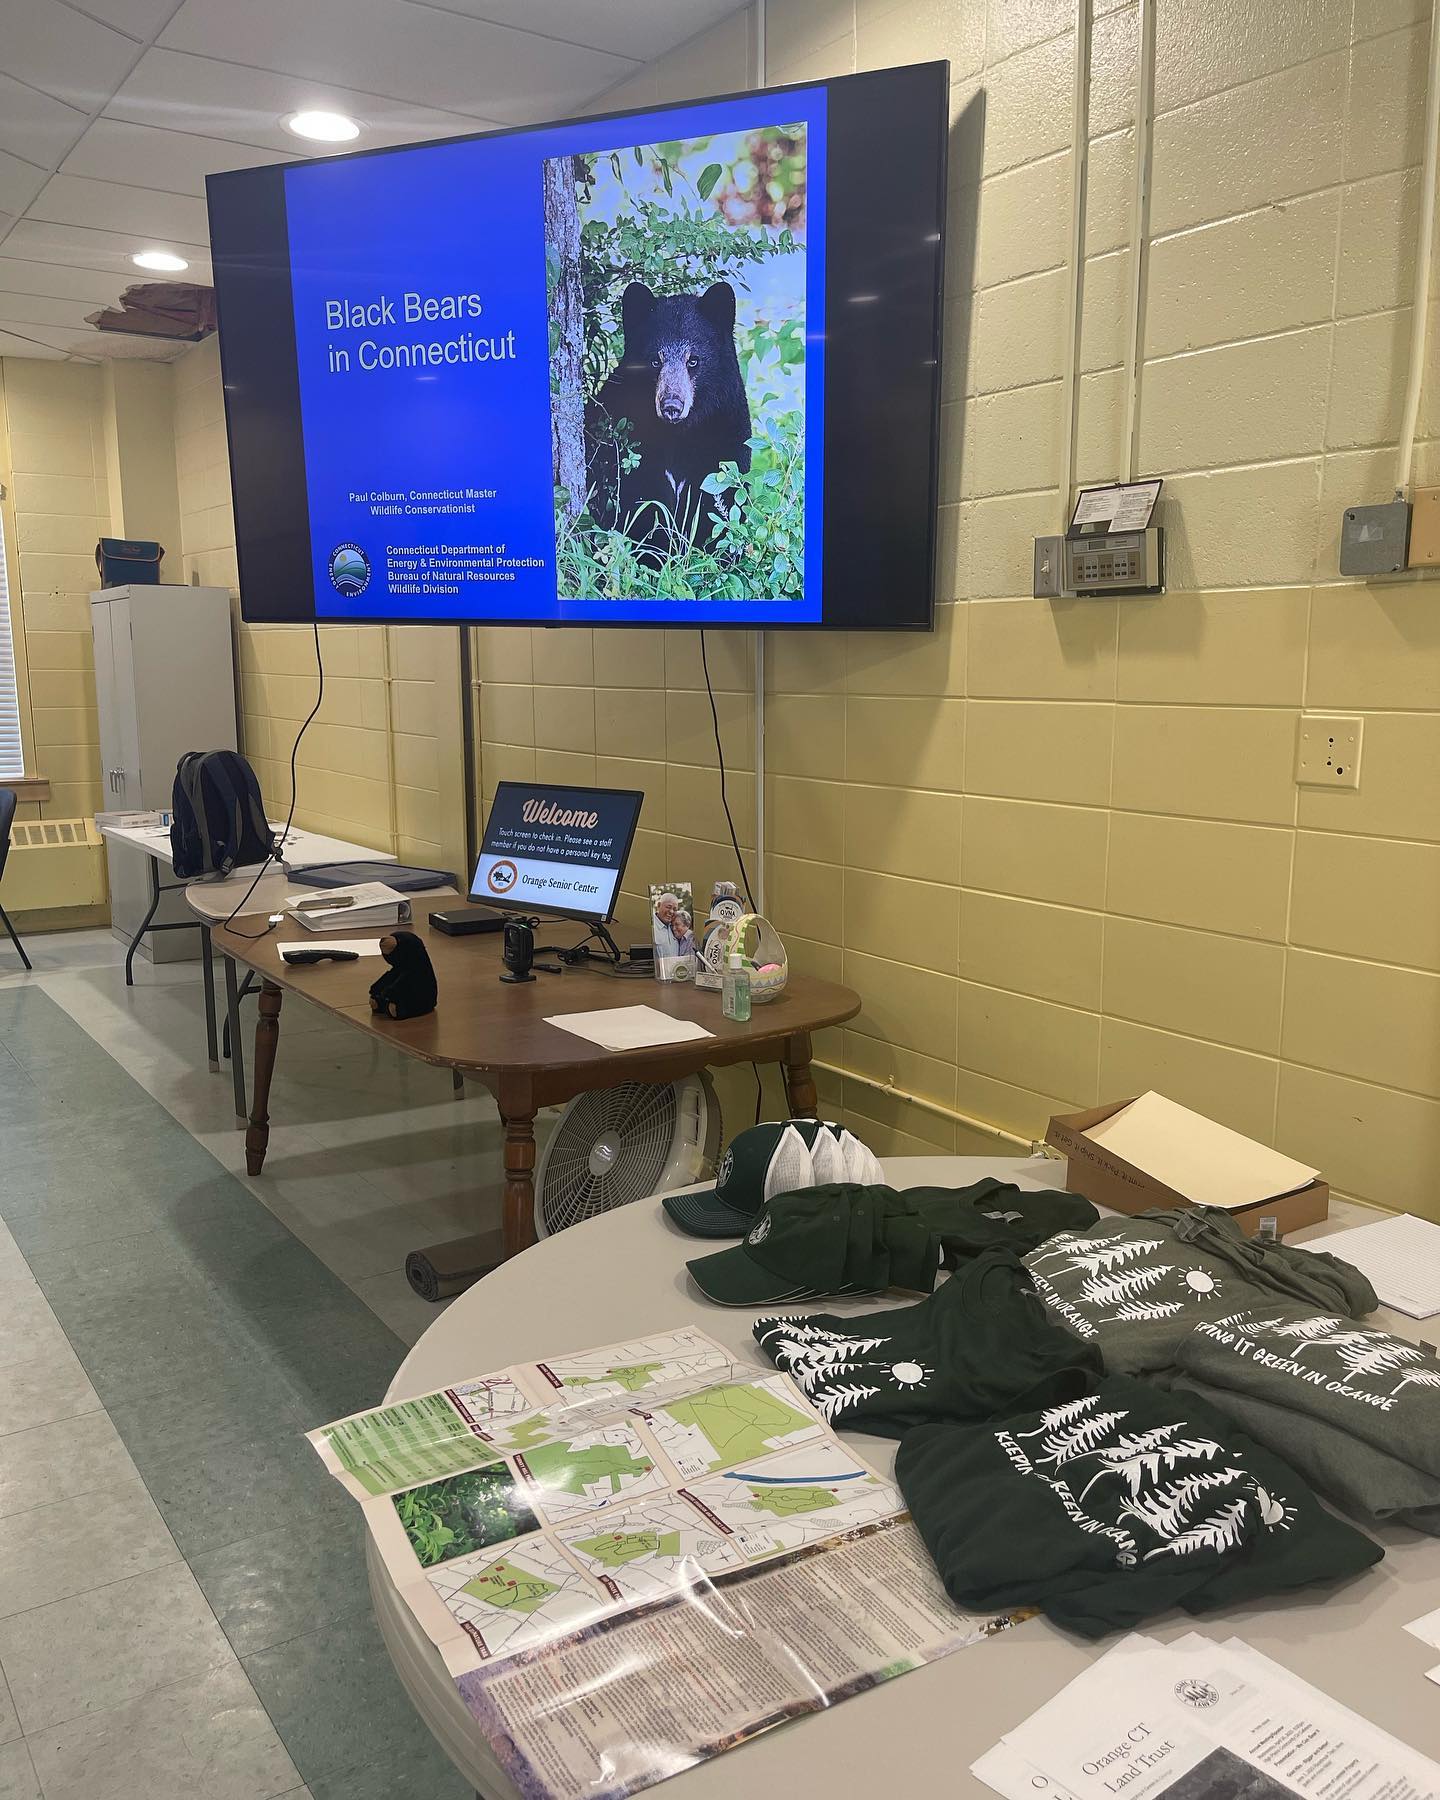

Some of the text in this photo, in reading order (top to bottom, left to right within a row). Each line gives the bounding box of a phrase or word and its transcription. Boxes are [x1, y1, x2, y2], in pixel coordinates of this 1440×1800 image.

[325, 292, 482, 330] Black Bears
[328, 330, 516, 373] in Connecticut
[349, 489, 497, 502] Paul Colburn, Connecticut Master
[370, 503, 476, 515] Wildlife Conservationist
[333, 543, 365, 557] CONNECTICUT
[386, 544, 506, 556] Connecticut Department of
[387, 557, 545, 570] Energy & Environmental Protection
[328, 563, 340, 590] ENERGY
[388, 571, 515, 581] Bureau of Natural Resources
[388, 584, 459, 594] Wildlife Division
[522, 798, 599, 829] Welcome
[498, 827, 514, 837] Touch
[514, 831, 532, 839] screen
[532, 832, 538, 840] to
[538, 832, 555, 842] check
[555, 834, 563, 842] in.
[564, 834, 582, 845] Please
[582, 838, 593, 846] see
[599, 837, 613, 847] staff
[491, 840, 613, 862] member if you do not have a personal key tag.
[522, 874, 548, 888] Orange
[549, 877, 572, 890] Senior
[573, 880, 600, 894] Center
[1056, 1302, 1099, 1338] ORANGE
[1233, 1337, 1255, 1356] IT
[1252, 1348, 1306, 1376] GREEN
[1302, 1370, 1327, 1385] IN
[1325, 1381, 1398, 1411] ORANGE
[1082, 1722, 1152, 1776] Orange CT
[1103, 1764, 1142, 1794] Land
[1135, 1740, 1176, 1768] Trust
